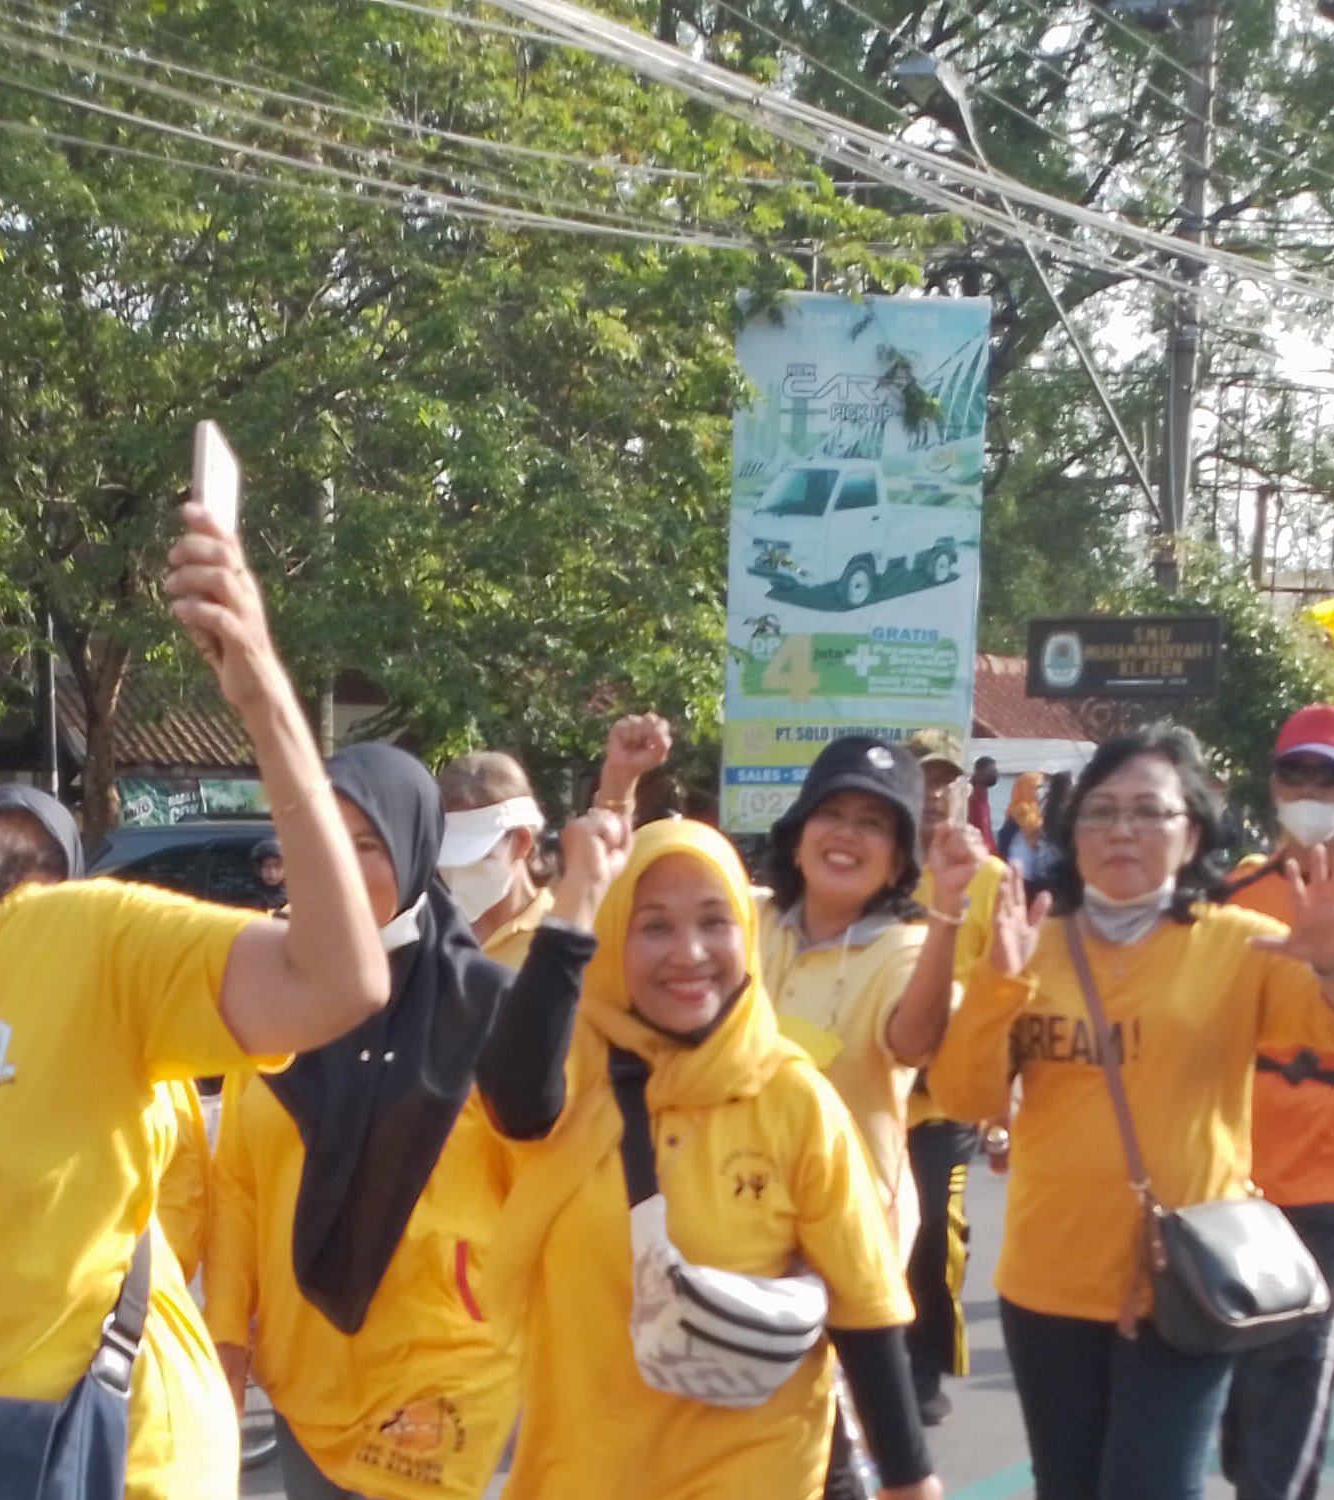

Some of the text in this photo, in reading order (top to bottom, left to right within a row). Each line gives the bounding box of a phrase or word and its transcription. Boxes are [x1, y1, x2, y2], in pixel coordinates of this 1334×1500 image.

[871, 626, 941, 642] GRATIS
[751, 637, 782, 655] DP
[762, 633, 820, 703] 4
[796, 727, 829, 742] SOLO
[737, 768, 781, 782] SALES
